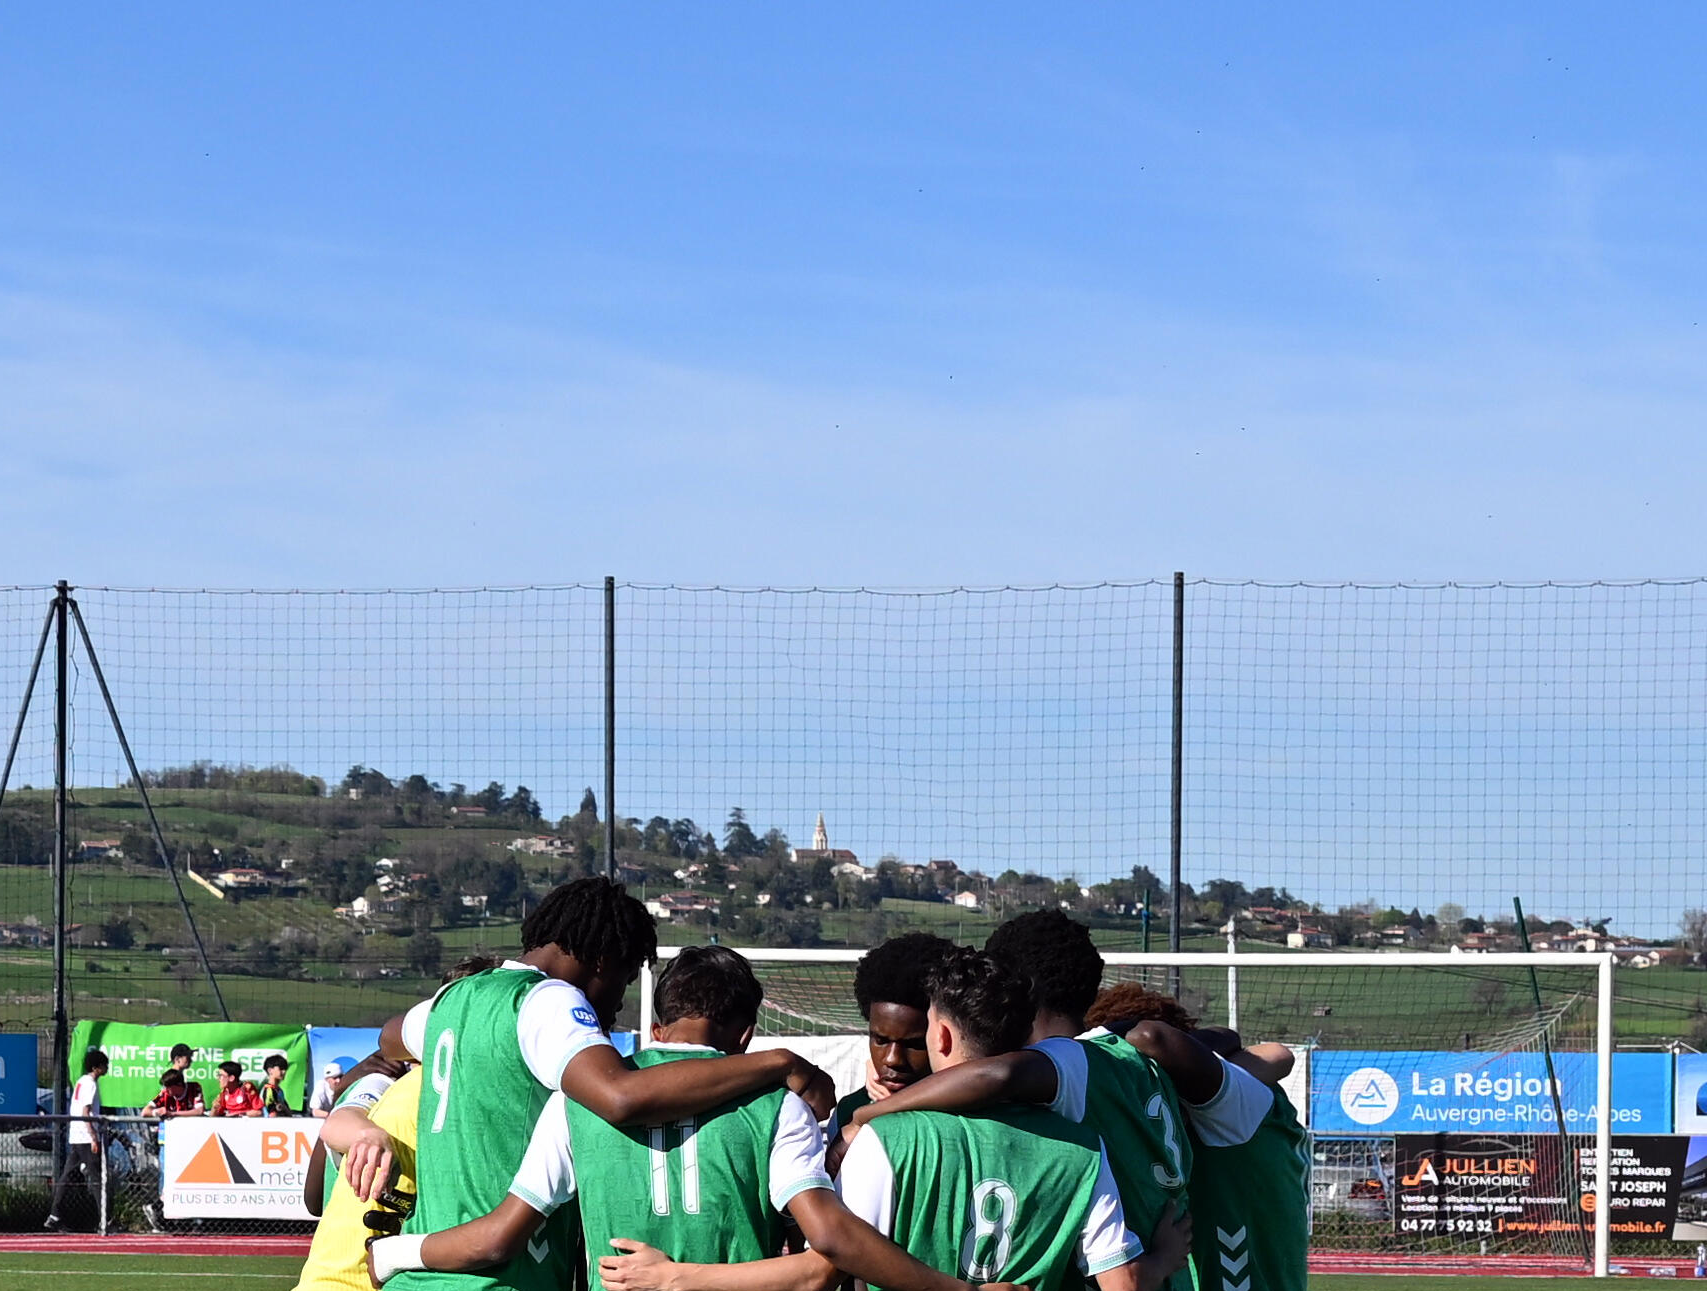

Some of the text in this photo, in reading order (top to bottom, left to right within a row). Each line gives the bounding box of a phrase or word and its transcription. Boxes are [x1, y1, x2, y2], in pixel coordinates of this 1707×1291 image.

[431, 1028, 455, 1134] 9
[1412, 1071, 1562, 1102] La Région
[1145, 1091, 1185, 1189] 3
[645, 1114, 700, 1215] 11
[1441, 1158, 1536, 1175] JULLIEN
[1622, 1167, 1671, 1176] MARQUES
[1444, 1176, 1531, 1186] AUTOMOBILE
[1620, 1181, 1666, 1192] JOSEPH
[172, 1194, 264, 1205] PLUS DE 30 ANS
[1632, 1197, 1666, 1207] REPAR
[960, 1177, 1017, 1282] 8
[1401, 1220, 1492, 1232] 04 77 92 32
